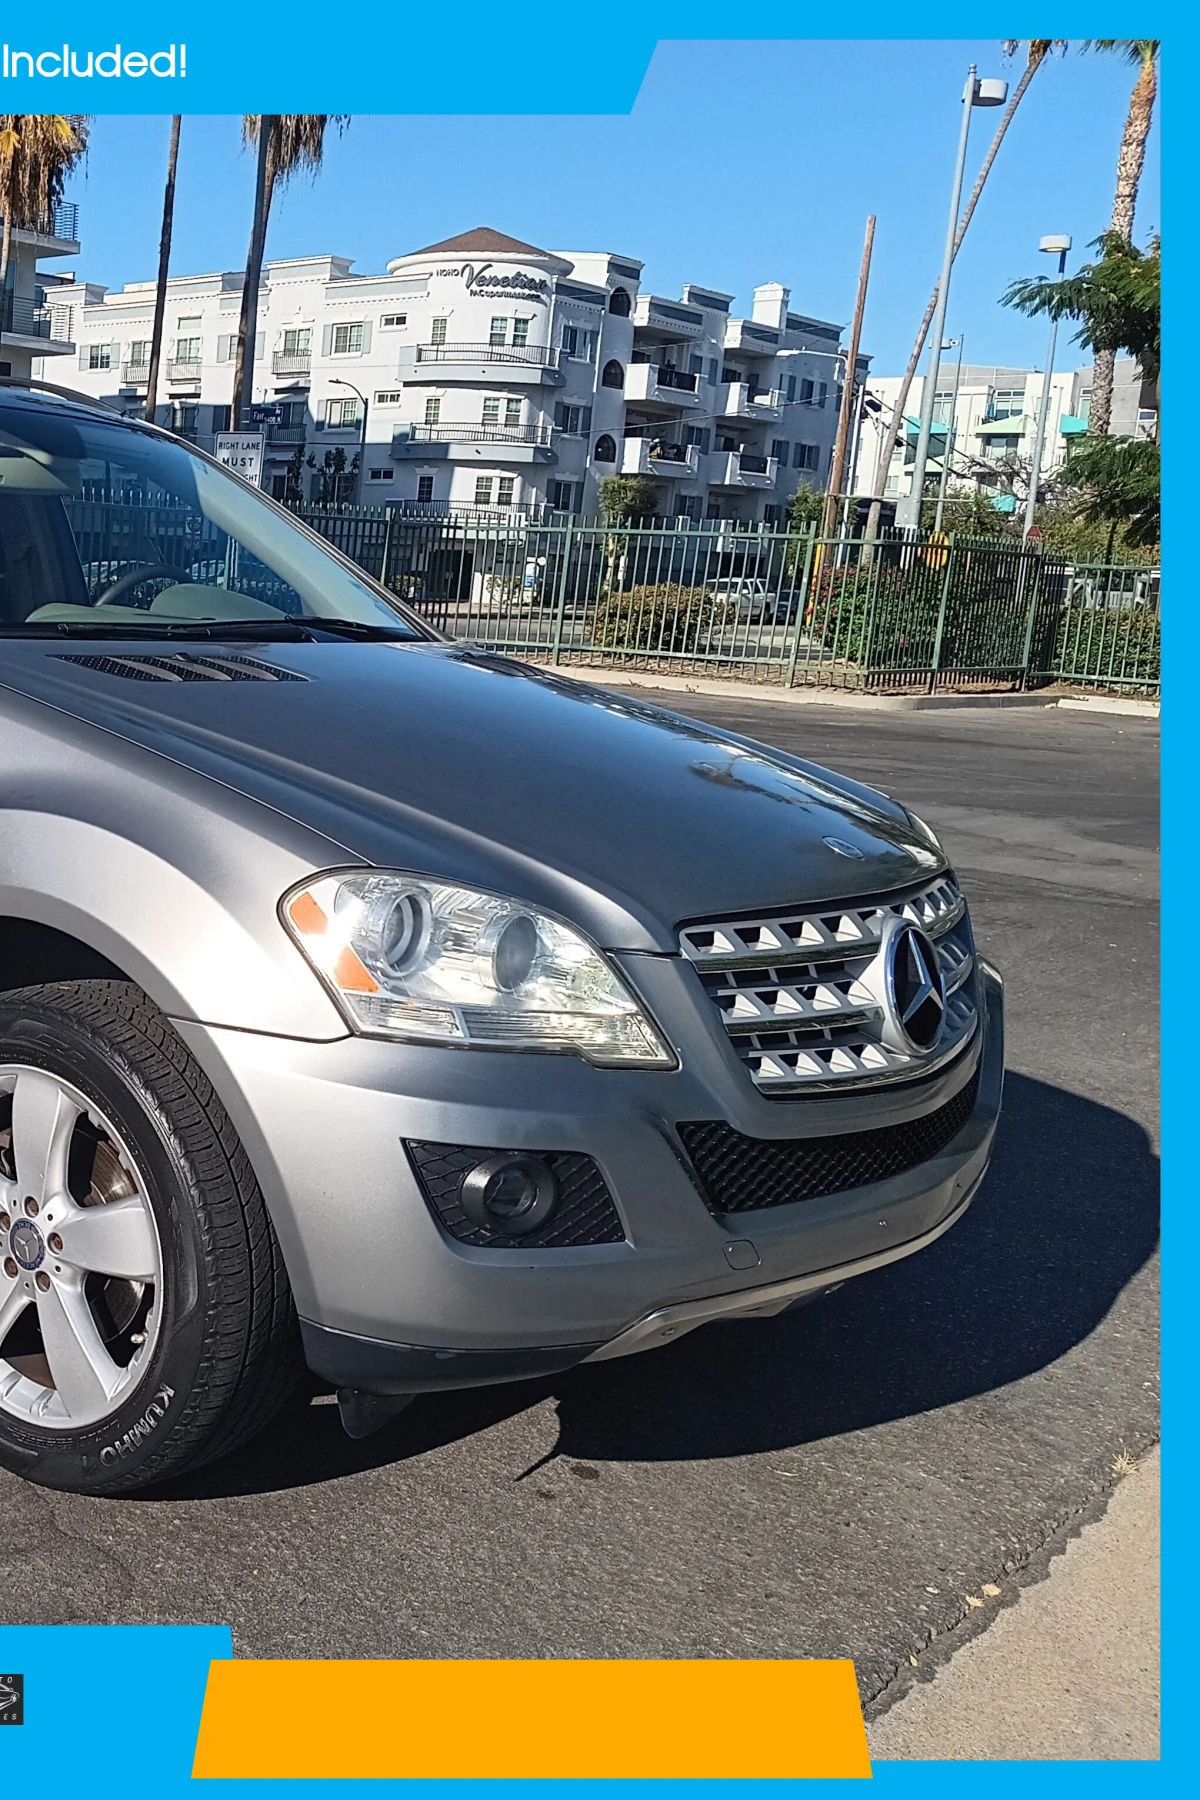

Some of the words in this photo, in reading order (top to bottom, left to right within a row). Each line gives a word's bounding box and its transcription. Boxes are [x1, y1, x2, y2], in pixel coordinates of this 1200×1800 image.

[460, 263, 548, 292] Venetian
[253, 411, 265, 421] Fair
[218, 442, 240, 450] RIGHT
[241, 442, 261, 450] LANE
[222, 457, 255, 467] MUST
[241, 474, 258, 482] GHT
[100, 1382, 175, 1467] KUMHO
